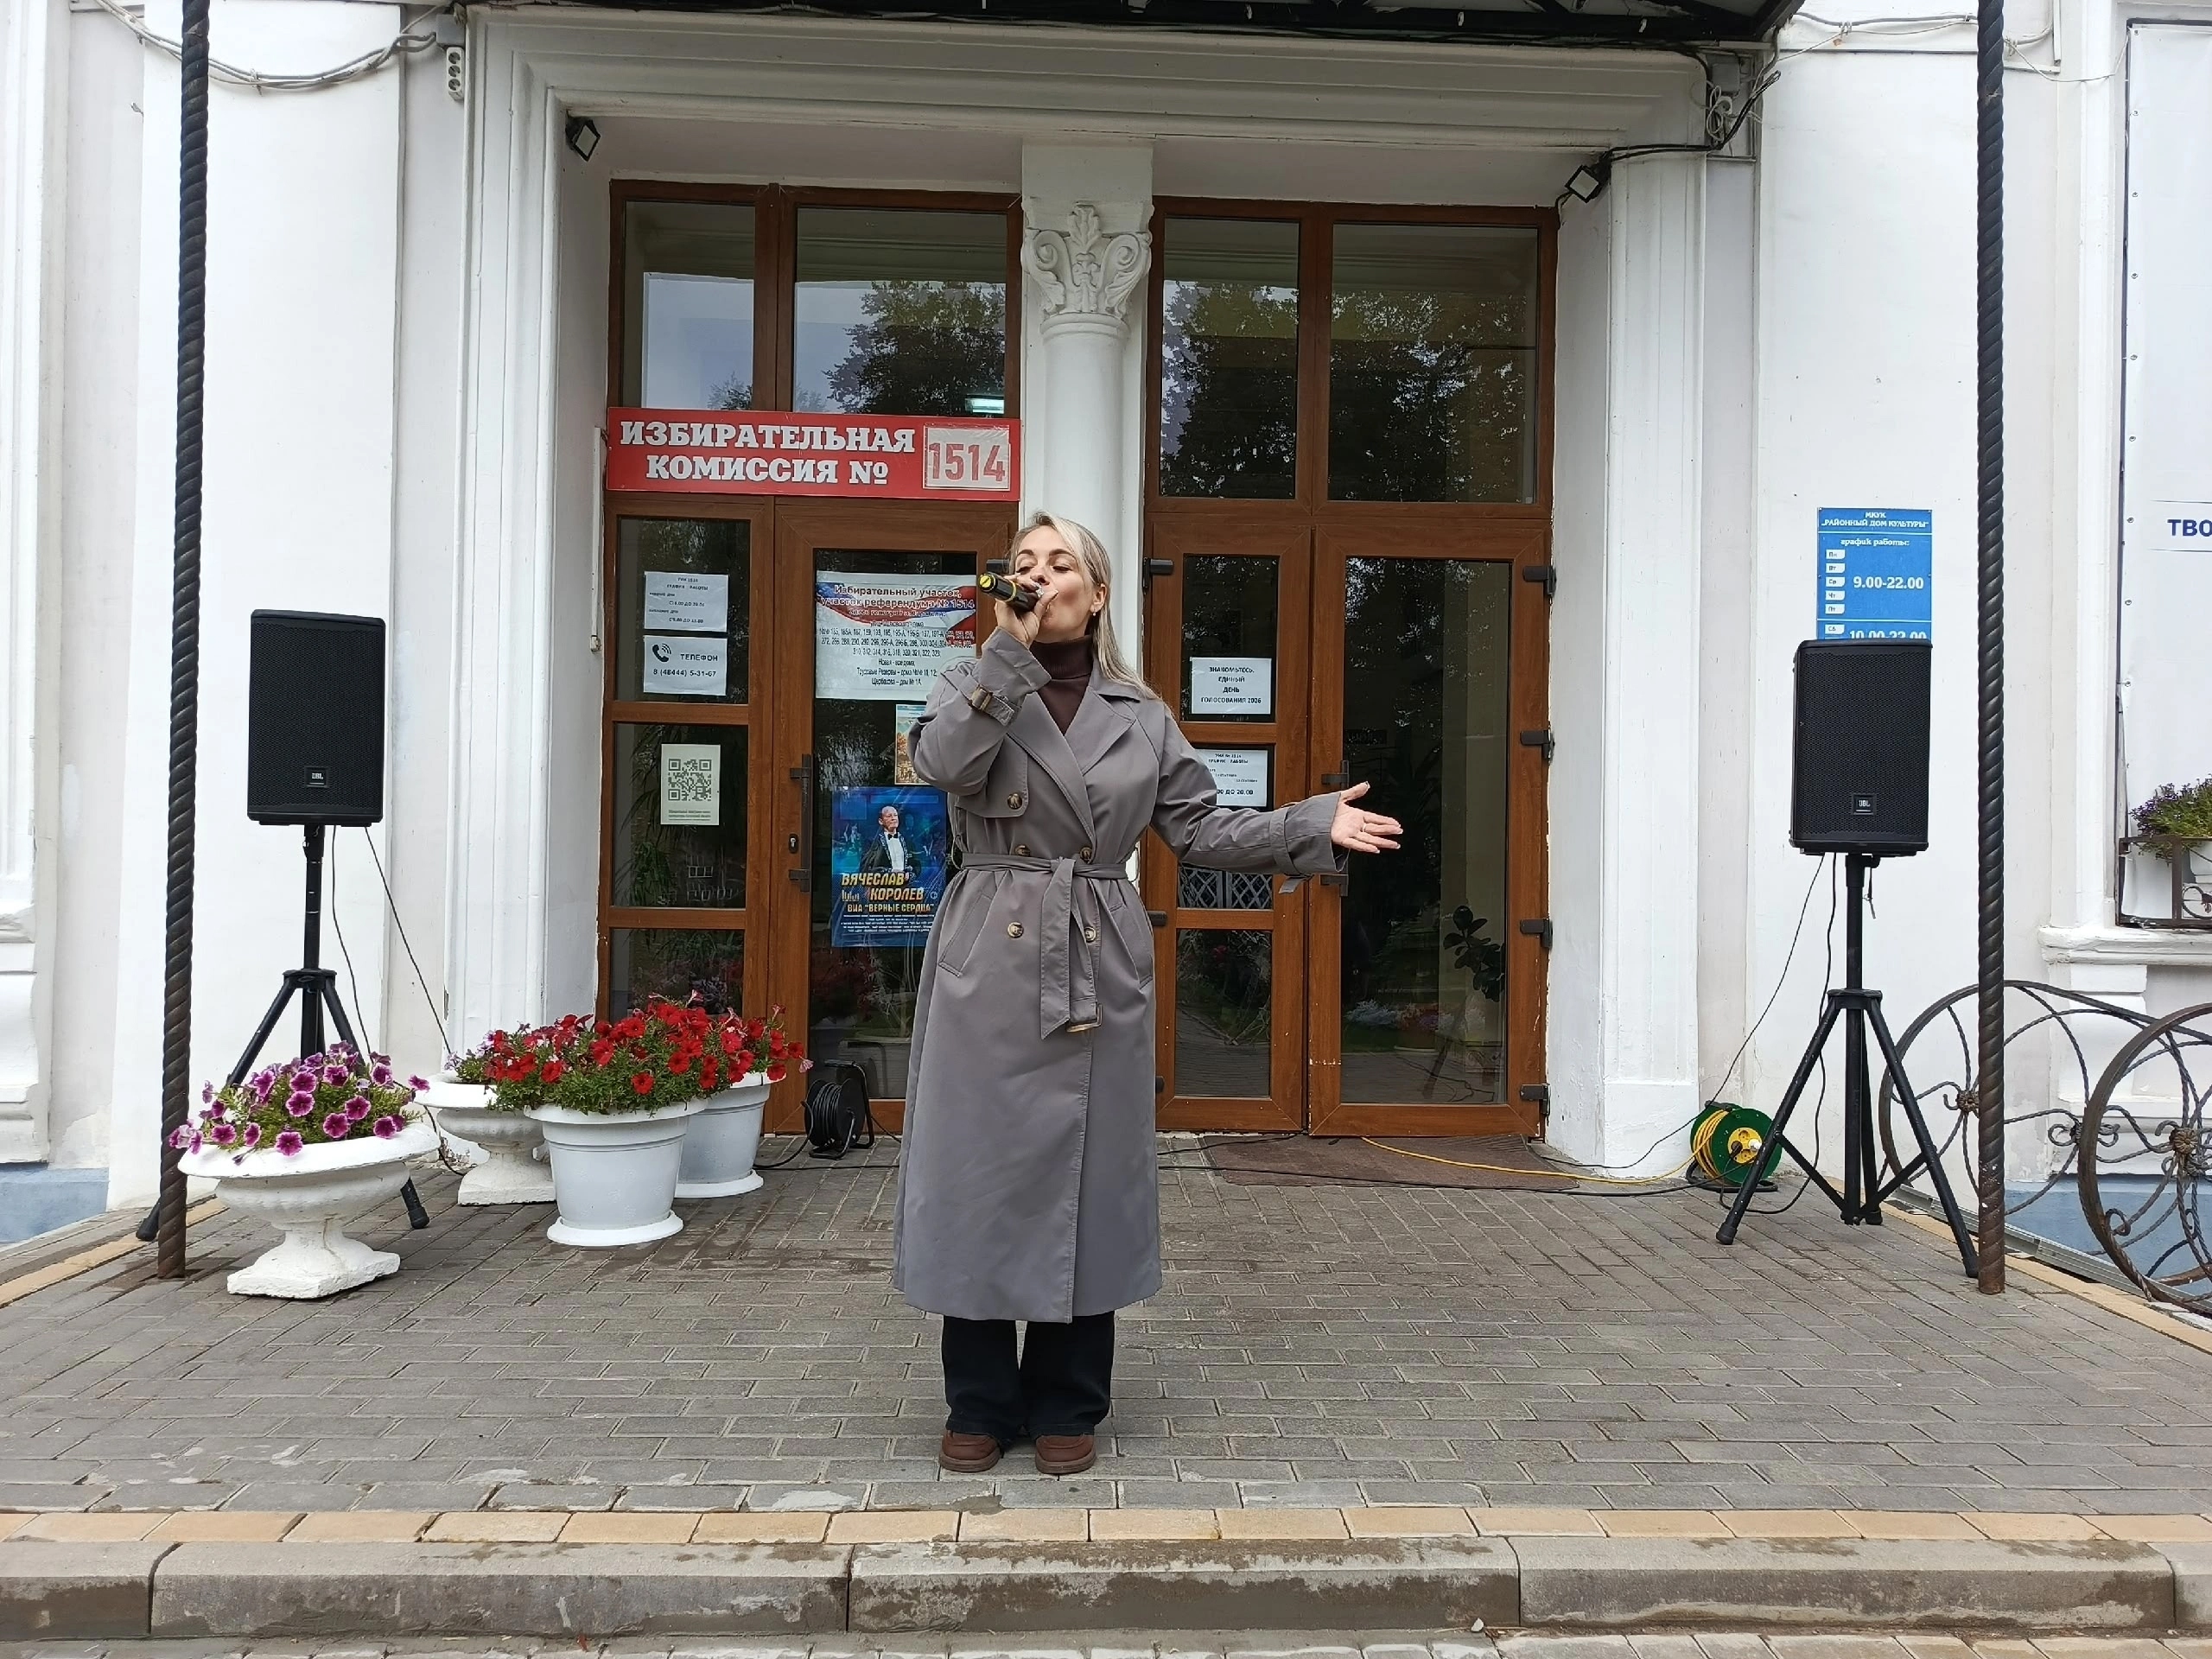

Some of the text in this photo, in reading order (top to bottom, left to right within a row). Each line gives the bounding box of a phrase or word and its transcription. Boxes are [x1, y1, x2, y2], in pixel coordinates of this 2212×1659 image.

[620, 421, 915, 453] ИЗБИРАТЕЛЬНАЯ
[929, 442, 1006, 482] 1514
[645, 454, 888, 485] КОМИССИЯ №
[2167, 519, 2212, 537] ТВО
[1840, 537, 1872, 546] график
[1853, 576, 1924, 589] 9.00-22.00
[834, 585, 962, 599] Избирательный участок,
[822, 597, 862, 606] участок
[865, 599, 936, 610] референдума
[950, 598, 975, 608] 1514
[680, 653, 718, 662] ТЕЛЕФОН
[660, 669, 687, 677] (48444)
[842, 873, 905, 886] ВЯЧЕСЛАВ
[870, 887, 925, 901] КОРОЛЕВ
[848, 904, 863, 913] ВИА
